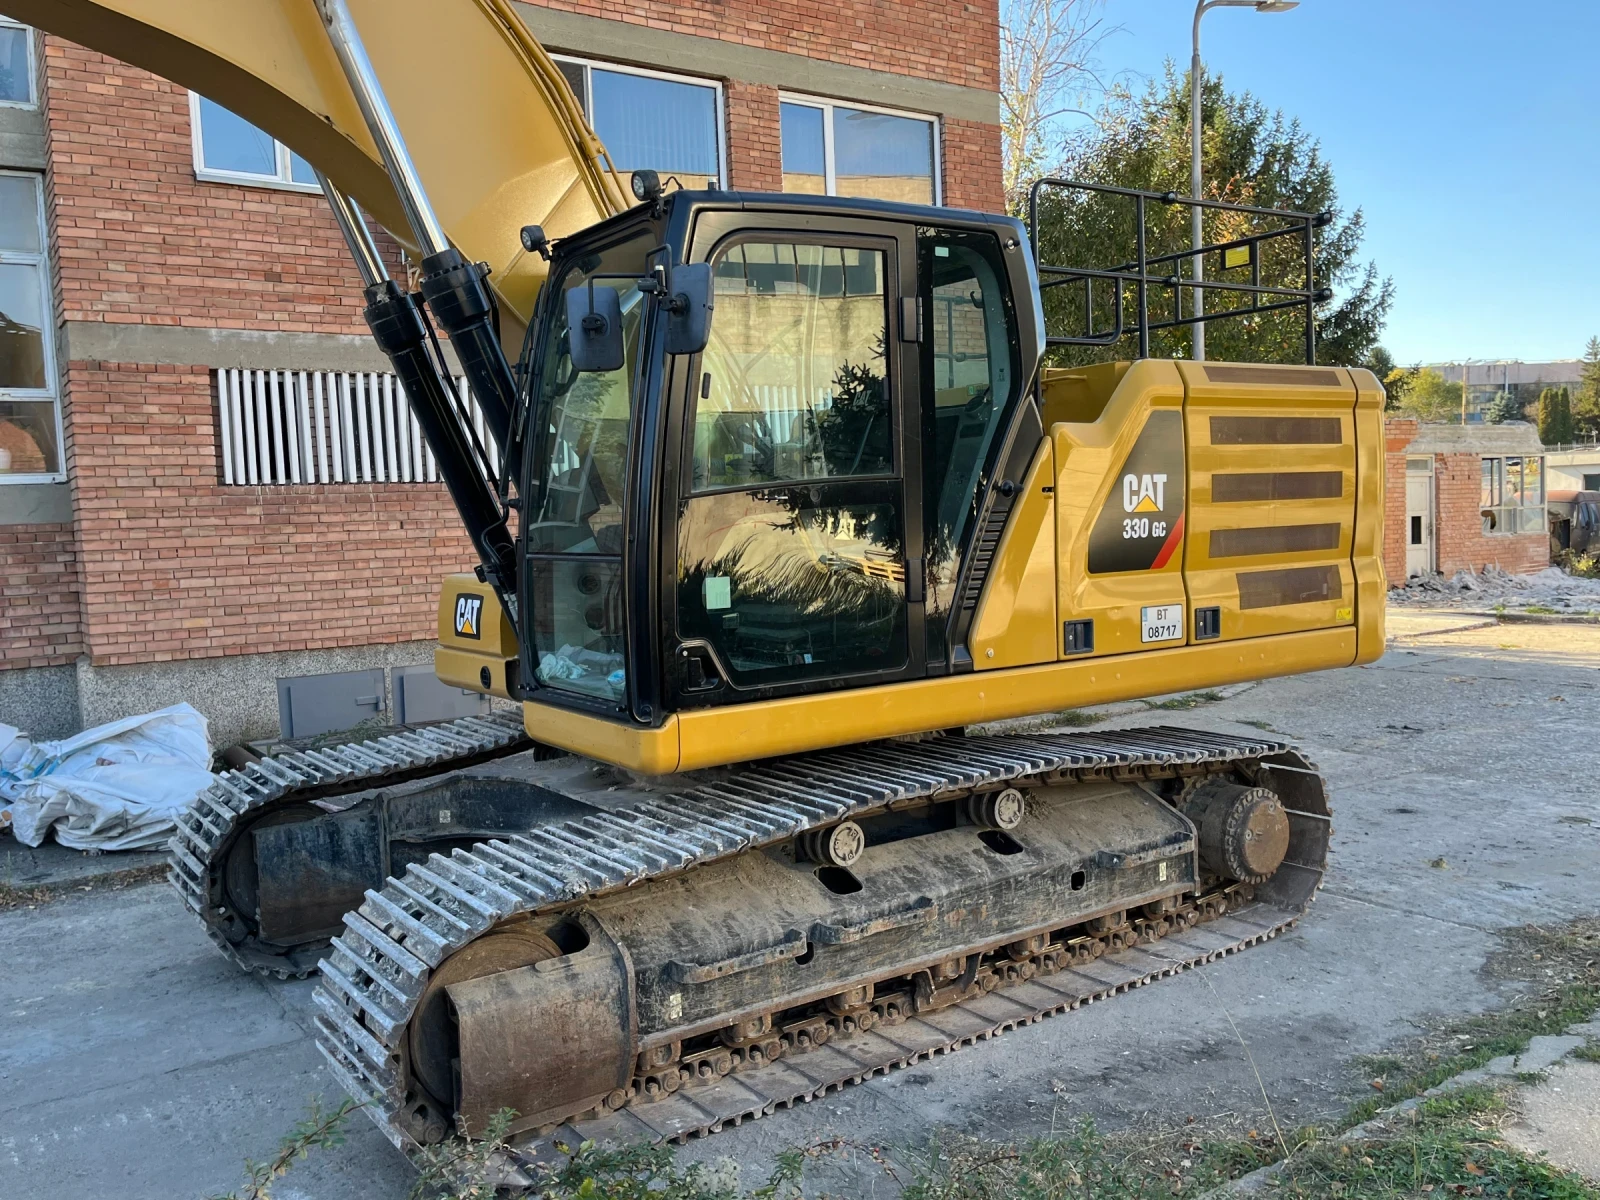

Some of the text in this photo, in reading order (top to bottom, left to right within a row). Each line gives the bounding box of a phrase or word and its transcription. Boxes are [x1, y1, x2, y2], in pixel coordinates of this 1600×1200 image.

[1123, 473, 1168, 513] CAT
[1123, 518, 1167, 539] 330 GC
[456, 597, 481, 635] CAT
[1157, 608, 1168, 620] BT
[1148, 624, 1177, 638] 08717
